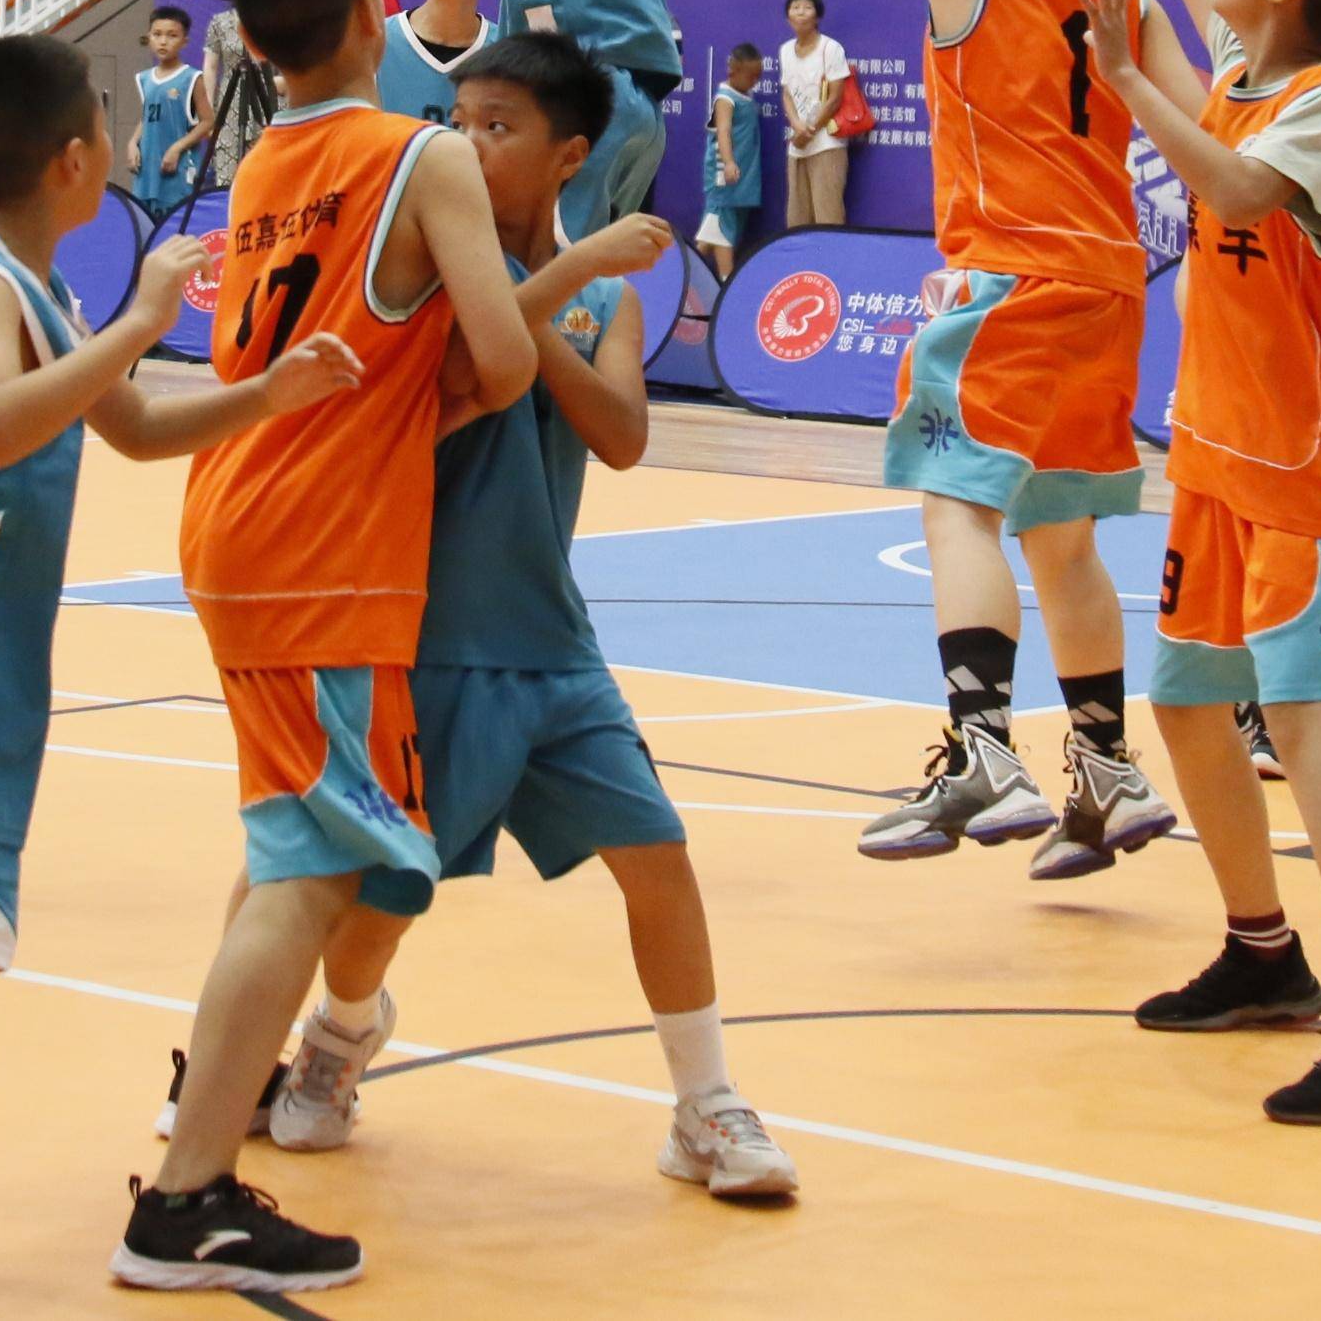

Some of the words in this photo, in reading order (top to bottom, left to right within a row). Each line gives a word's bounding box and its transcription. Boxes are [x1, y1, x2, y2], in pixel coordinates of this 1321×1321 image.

[148, 103, 161, 124] 21
[836, 334, 914, 356] 您身边
